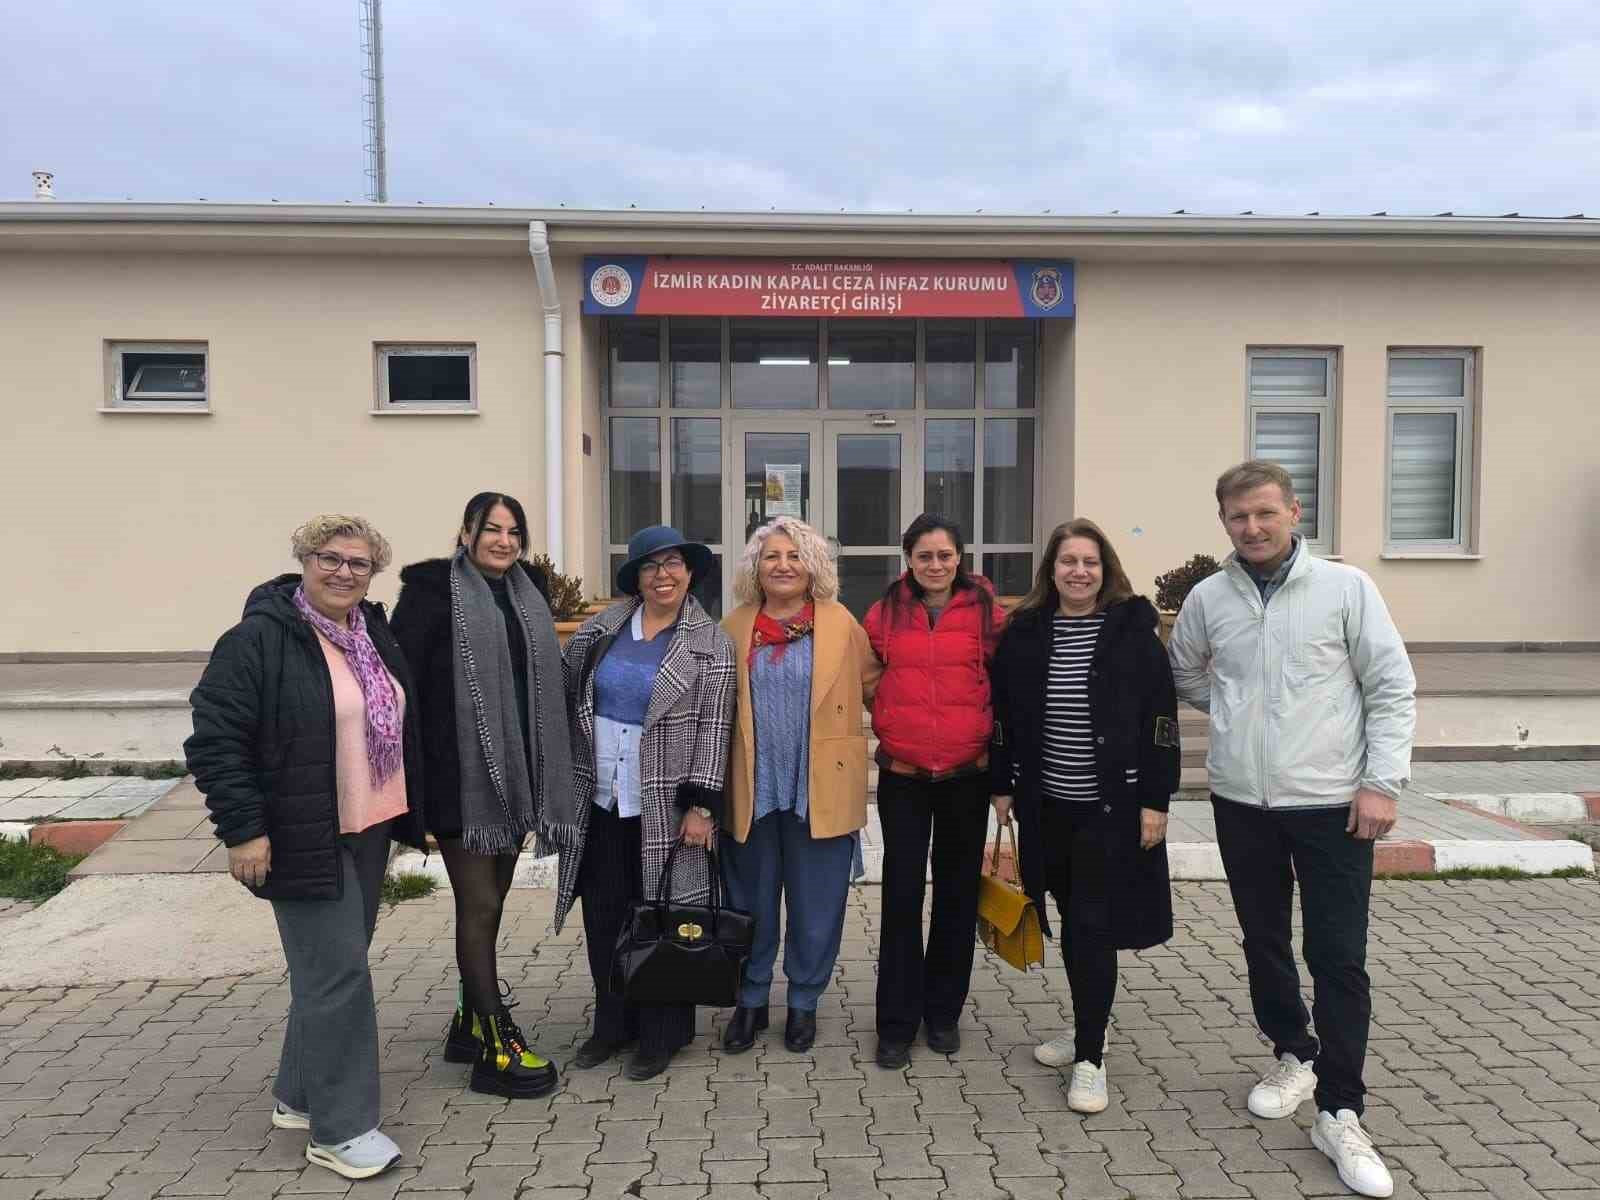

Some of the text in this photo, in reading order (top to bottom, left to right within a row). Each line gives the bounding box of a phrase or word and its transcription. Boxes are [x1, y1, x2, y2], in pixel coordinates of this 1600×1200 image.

[791, 264, 804, 272] T.C.
[805, 264, 833, 272] ADALET
[654, 271, 1008, 291] İZMİR KADIN KAPALI CEZA İNFAZ KURUMU
[761, 293, 902, 314] ZİYARETÇİ GİRİŞİ
